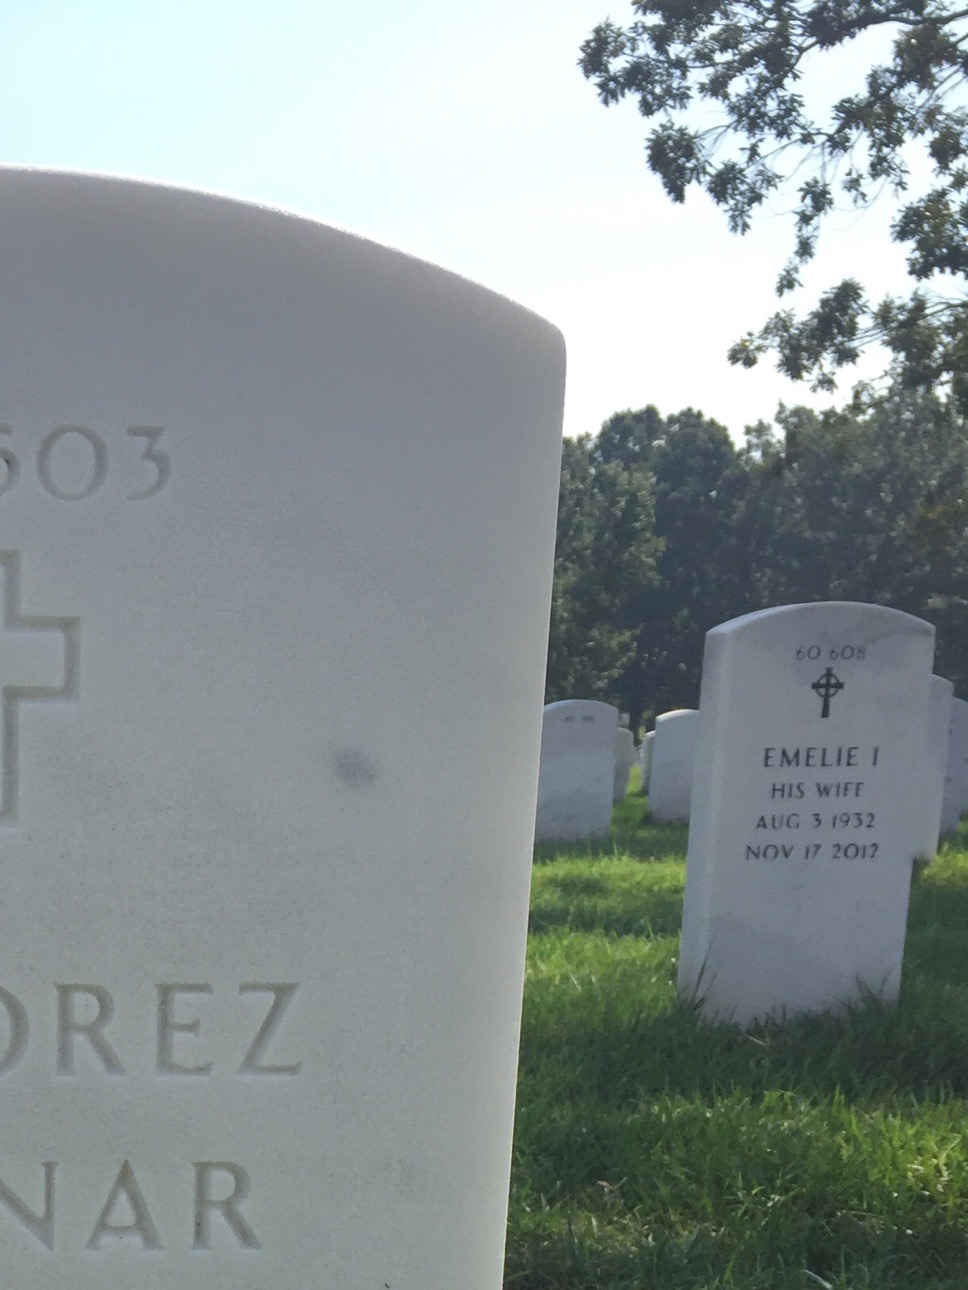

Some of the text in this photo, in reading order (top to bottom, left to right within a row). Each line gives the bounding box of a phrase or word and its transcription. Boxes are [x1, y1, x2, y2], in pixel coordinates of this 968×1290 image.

[796, 645, 822, 660] 60
[763, 746, 880, 767] EMELIE I
[771, 782, 865, 798] HIS WIFE
[755, 812, 876, 829] AUG 3 1932
[746, 842, 880, 860] NOV 17 2012
